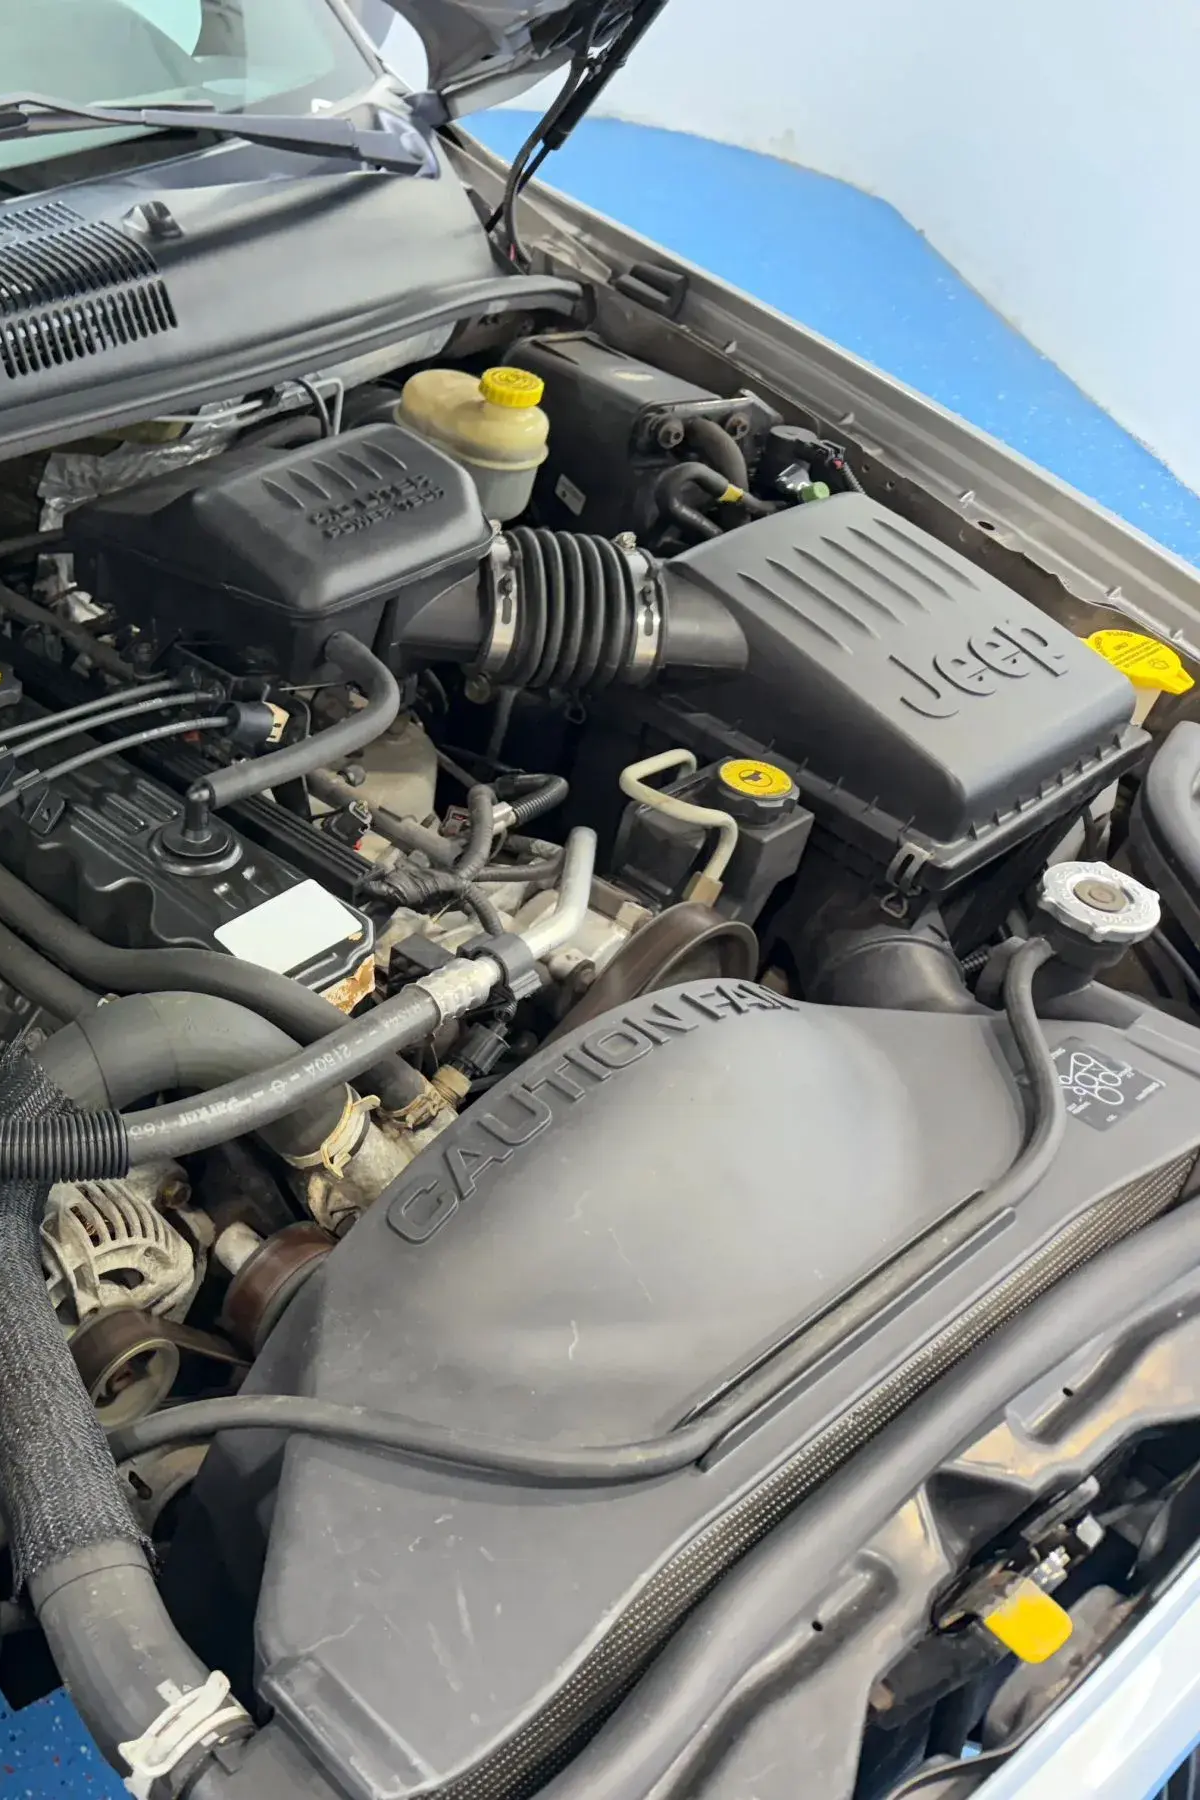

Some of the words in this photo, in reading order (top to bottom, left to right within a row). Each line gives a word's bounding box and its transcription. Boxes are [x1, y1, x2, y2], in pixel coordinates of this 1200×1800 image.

[322, 506, 395, 539] POWER
[393, 485, 445, 512] TECH
[887, 618, 1070, 720] Jeep
[386, 1000, 700, 1247] CAUTION
[680, 983, 800, 1022] FAN
